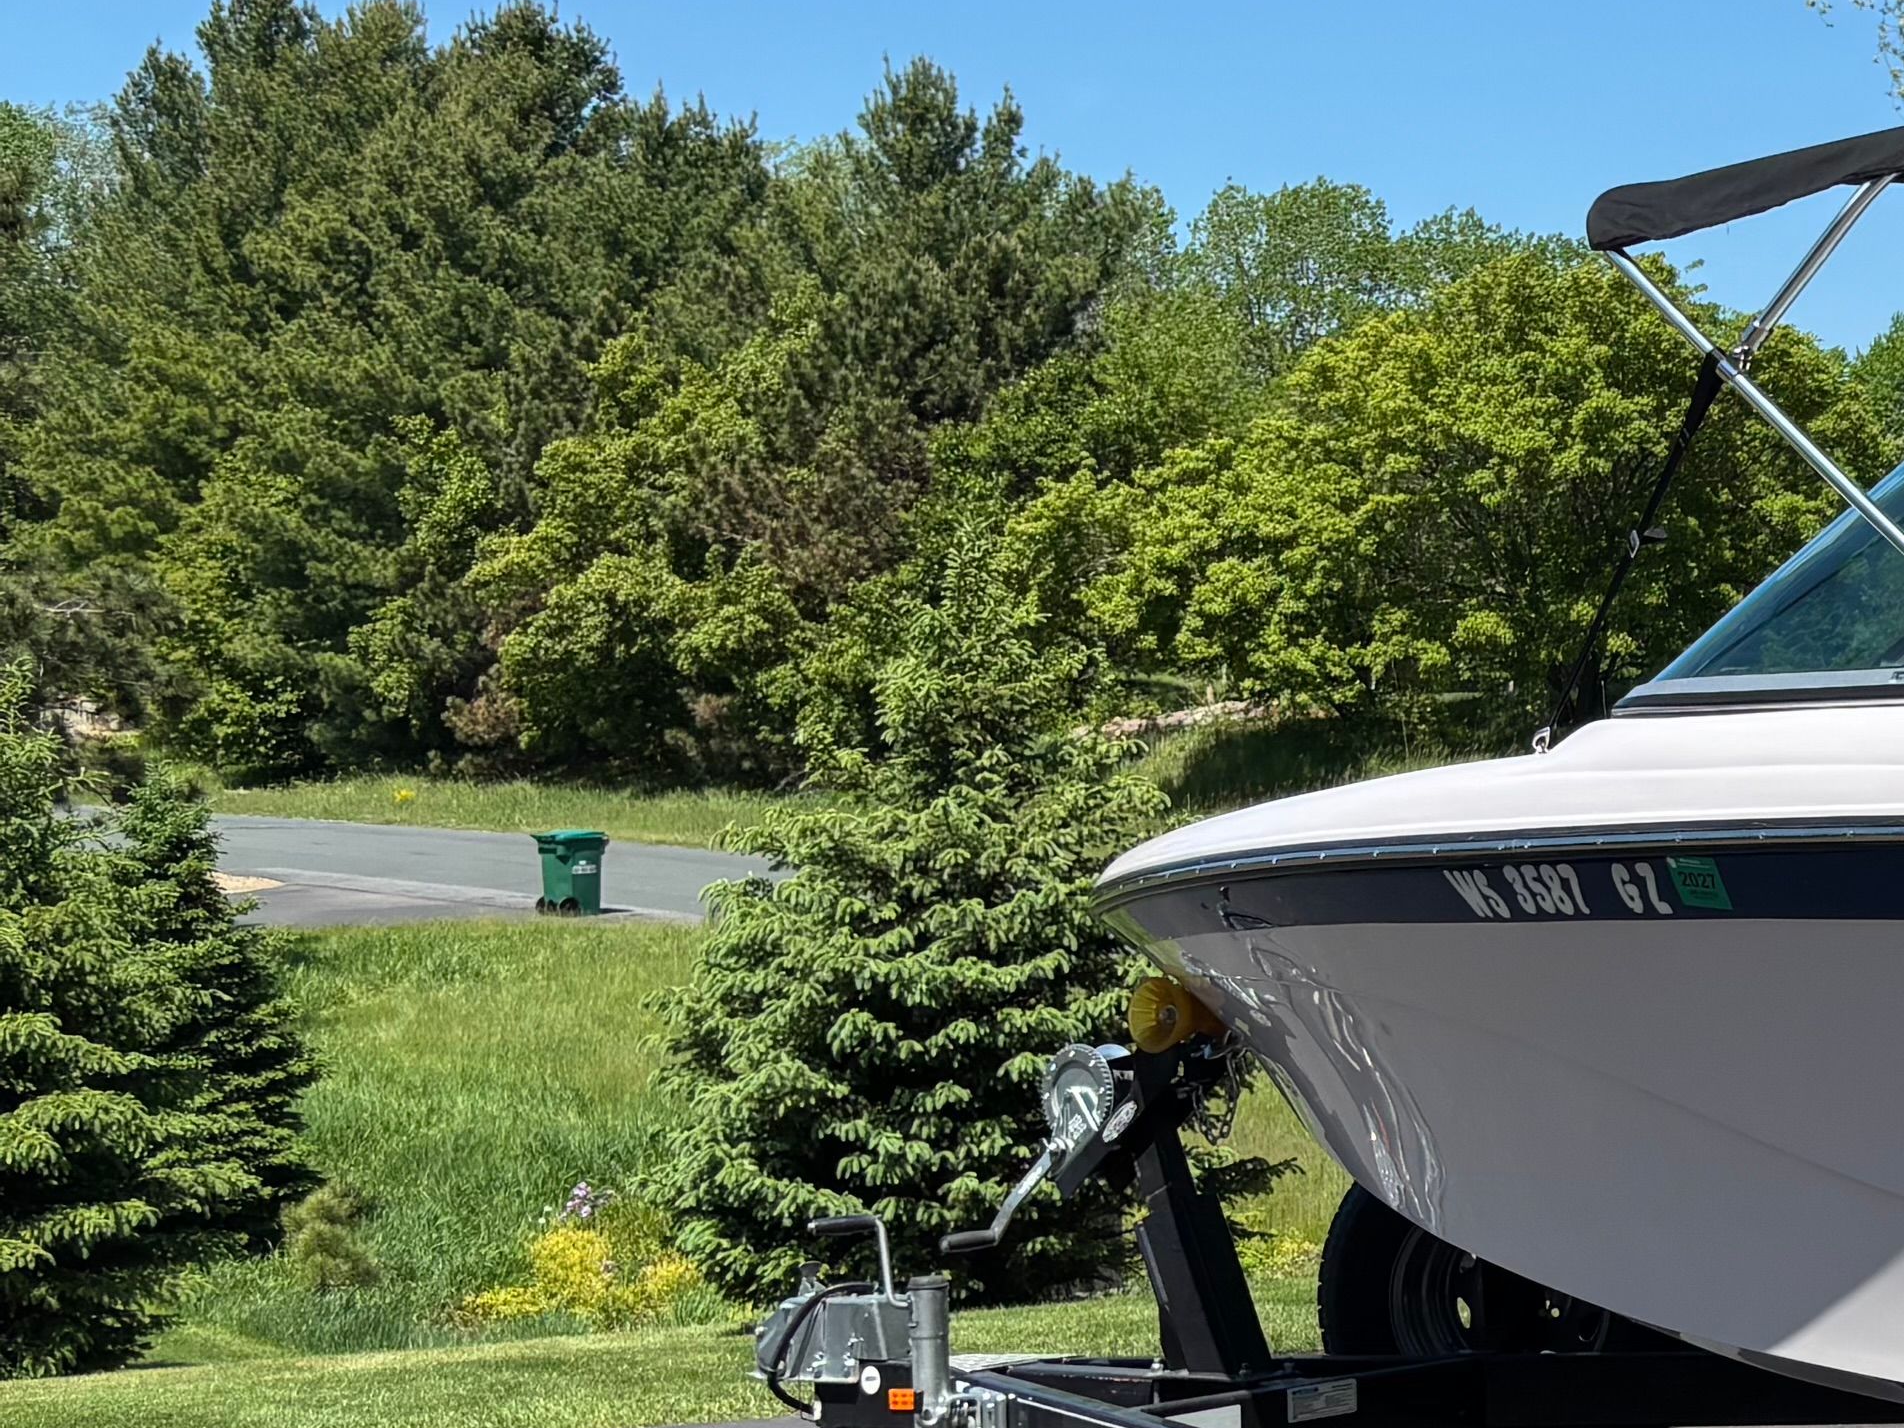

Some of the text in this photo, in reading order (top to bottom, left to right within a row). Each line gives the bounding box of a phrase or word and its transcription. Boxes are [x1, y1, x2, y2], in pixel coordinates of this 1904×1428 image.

[1443, 870, 1511, 918] WS
[1503, 864, 1590, 915] 3587
[1678, 872, 1716, 889] 2027
